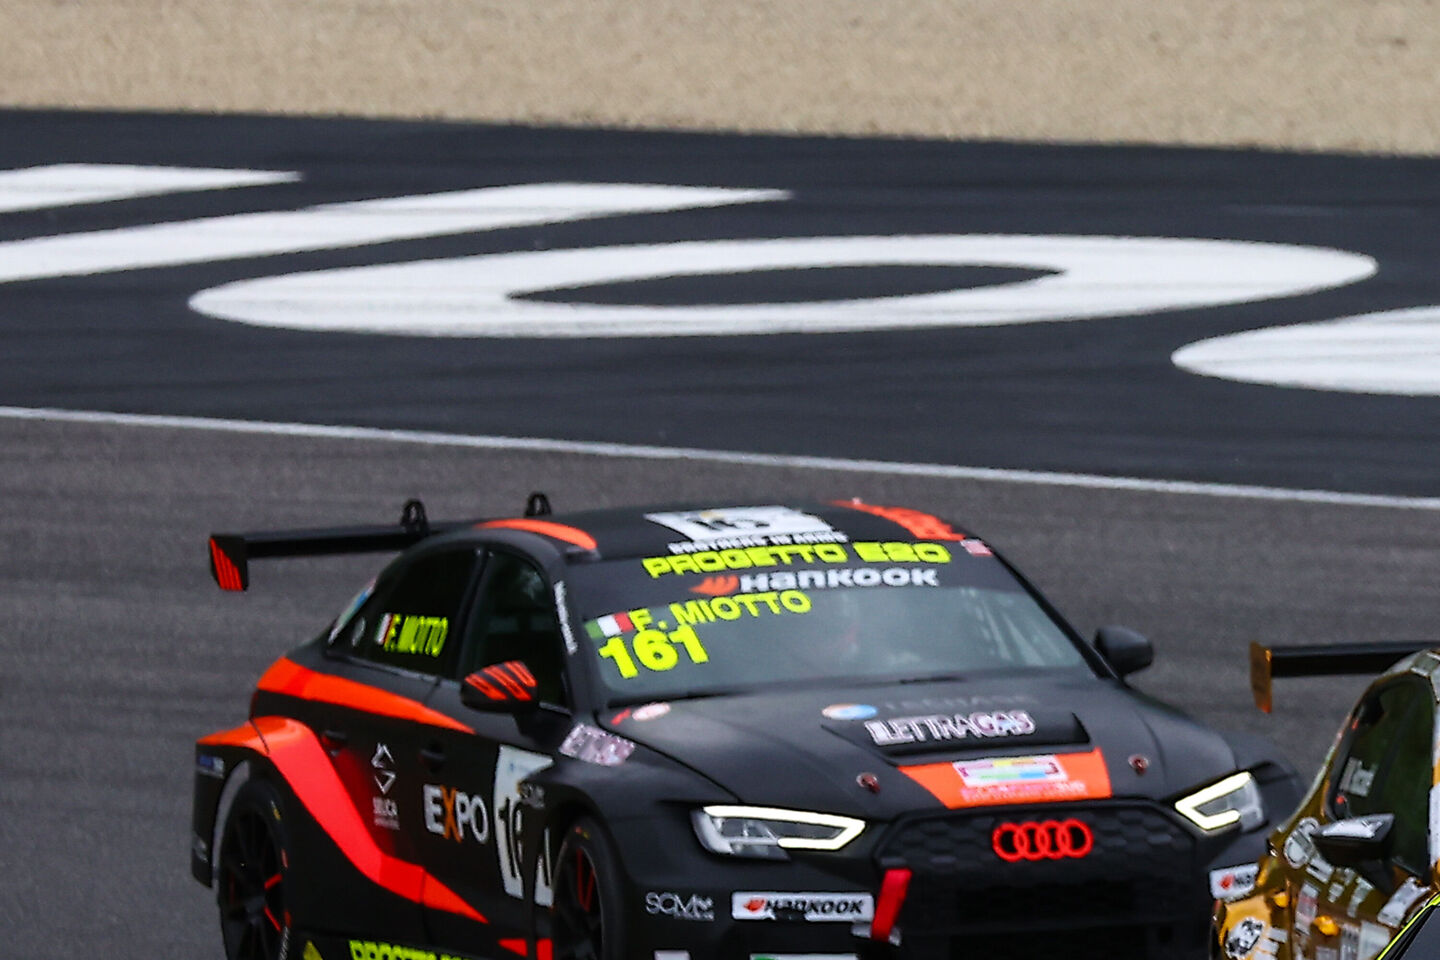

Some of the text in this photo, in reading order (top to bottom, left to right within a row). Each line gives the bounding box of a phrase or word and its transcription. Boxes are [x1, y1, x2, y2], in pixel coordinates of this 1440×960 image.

[642, 543, 848, 578] PROGETTO
[669, 590, 812, 626] MIOTTO
[599, 625, 709, 679] 161
[423, 784, 489, 845] EXPO
